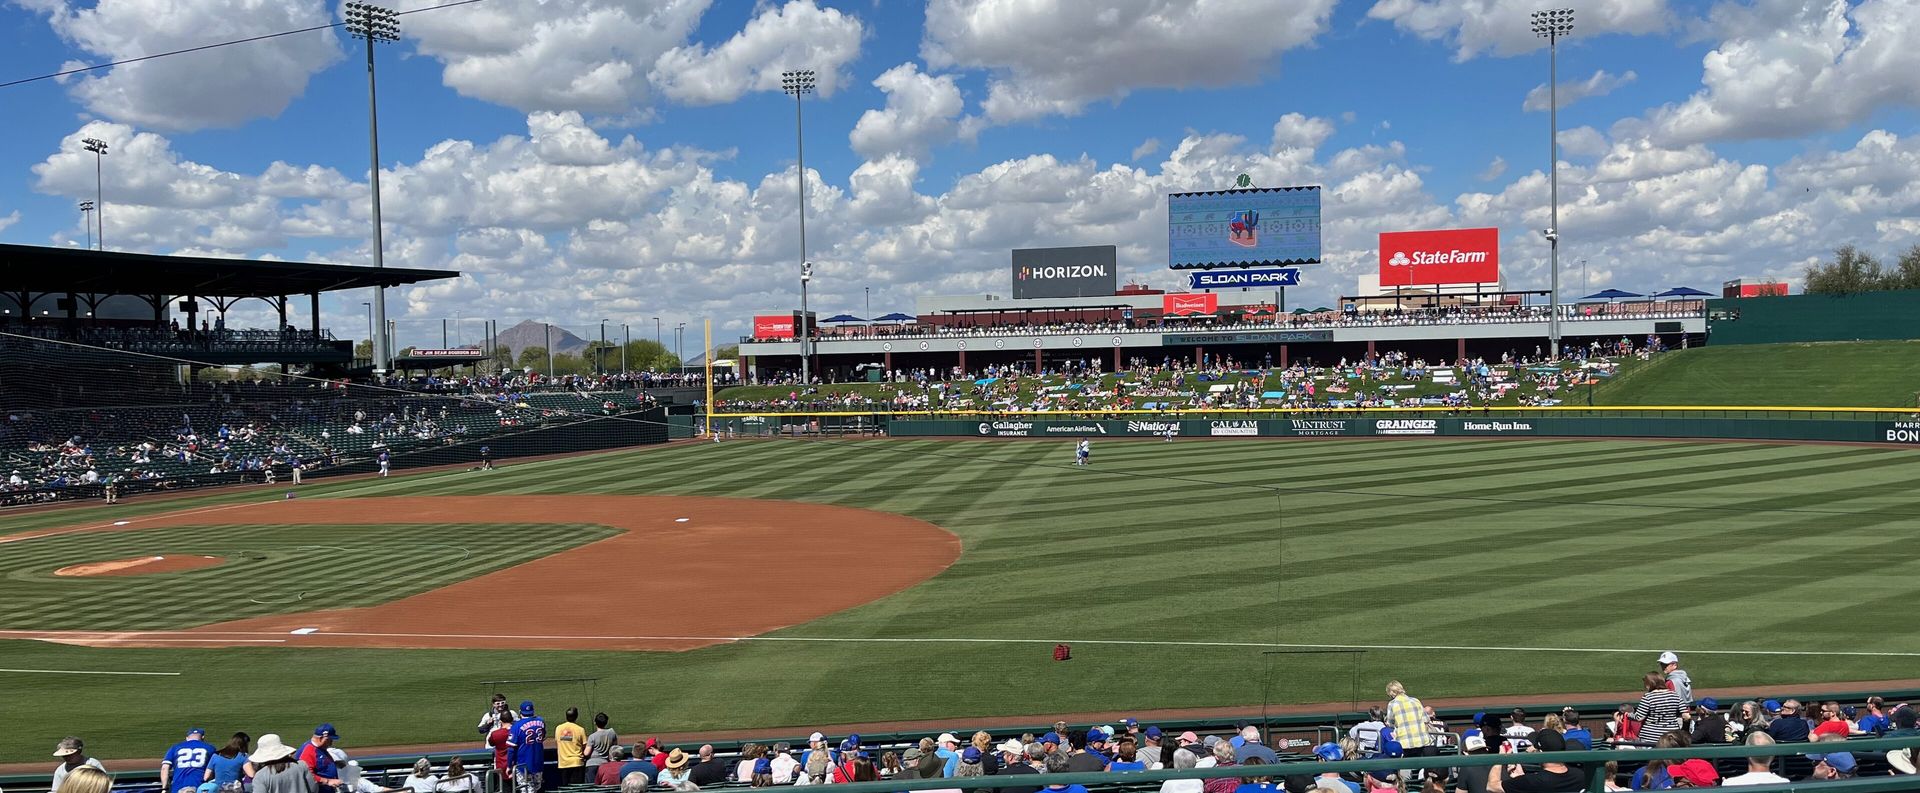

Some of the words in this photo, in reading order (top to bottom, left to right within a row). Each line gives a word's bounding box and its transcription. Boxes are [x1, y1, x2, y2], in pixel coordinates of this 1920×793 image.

[1200, 273, 1247, 284] SLOAN
[1251, 272, 1289, 283] PARK
[1235, 333, 1277, 342] SLOAN
[1280, 332, 1313, 341] PARK
[992, 421, 1033, 430] Gallagher
[1046, 425, 1074, 433] American
[1074, 424, 1097, 432] Airlines
[1211, 420, 1233, 429] CAL
[1241, 420, 1258, 429] AM
[1292, 419, 1346, 429] WINTRUST
[1463, 421, 1492, 430] Home
[1493, 421, 1512, 431] Run
[1513, 421, 1532, 430] Inn.
[1887, 429, 1919, 442] BON
[525, 727, 544, 745] 23
[177, 747, 208, 768] 23
